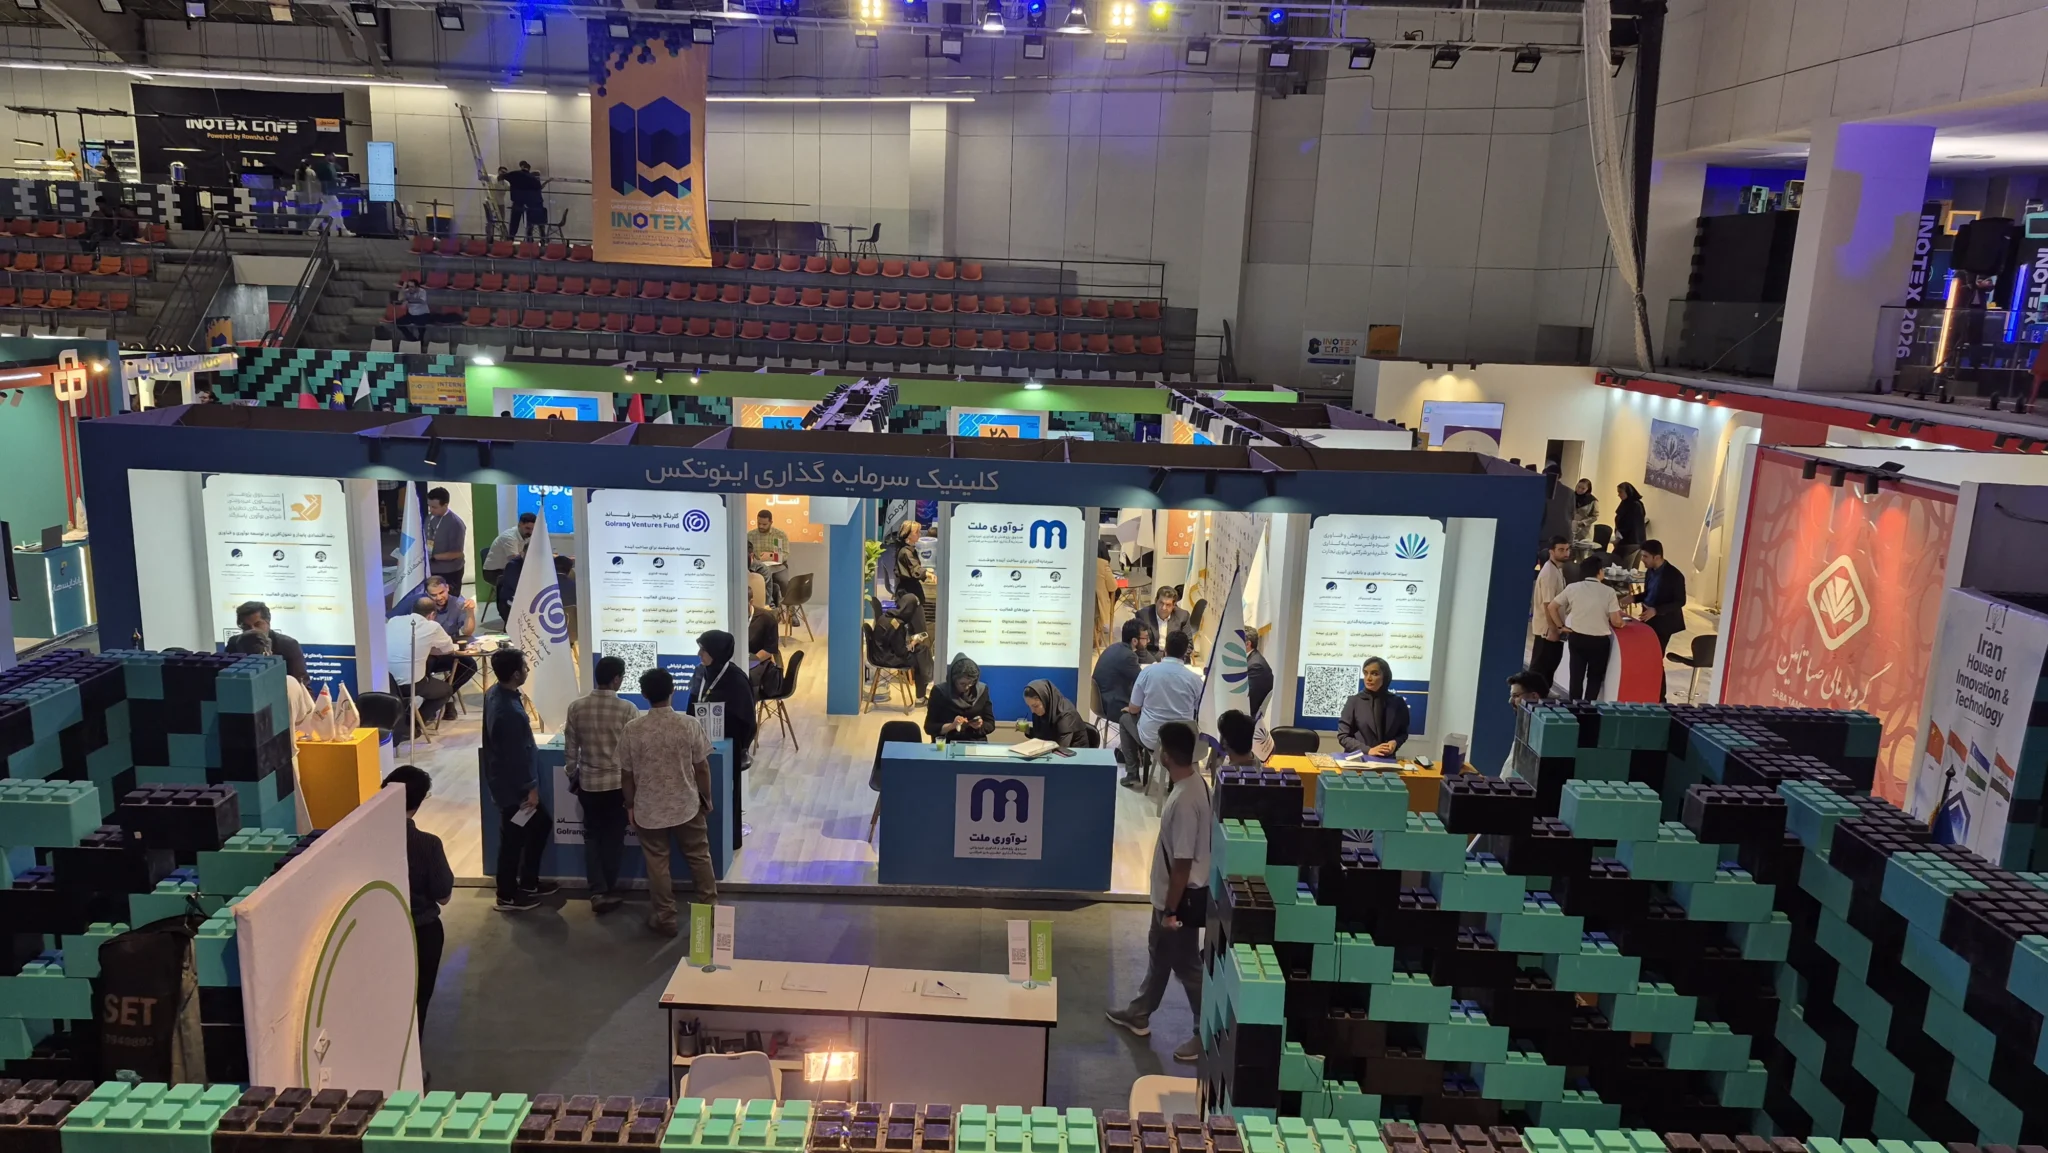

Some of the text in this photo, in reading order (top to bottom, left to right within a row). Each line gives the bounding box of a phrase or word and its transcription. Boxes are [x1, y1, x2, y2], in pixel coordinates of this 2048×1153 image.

[186, 119, 248, 131] INOTEX
[611, 212, 692, 232] INOTEX
[1897, 215, 1935, 358] INOTEX 2026
[1323, 338, 1358, 346] INOTEX
[646, 458, 999, 495] کلینیک سرمایه گذاری اینوتکس
[766, 495, 800, 506] سال
[968, 522, 1024, 534] نوآوری ملت
[1976, 633, 2003, 662] Iran
[1804, 658, 1824, 696] صبا
[1966, 653, 2008, 682] House of
[1772, 688, 1787, 704] SABA
[1820, 666, 1842, 700] مالی
[1956, 669, 2009, 705] Innovation &
[1955, 689, 2004, 728] Technology
[992, 833, 1027, 845] نوآوری
[104, 994, 158, 1026] SET
